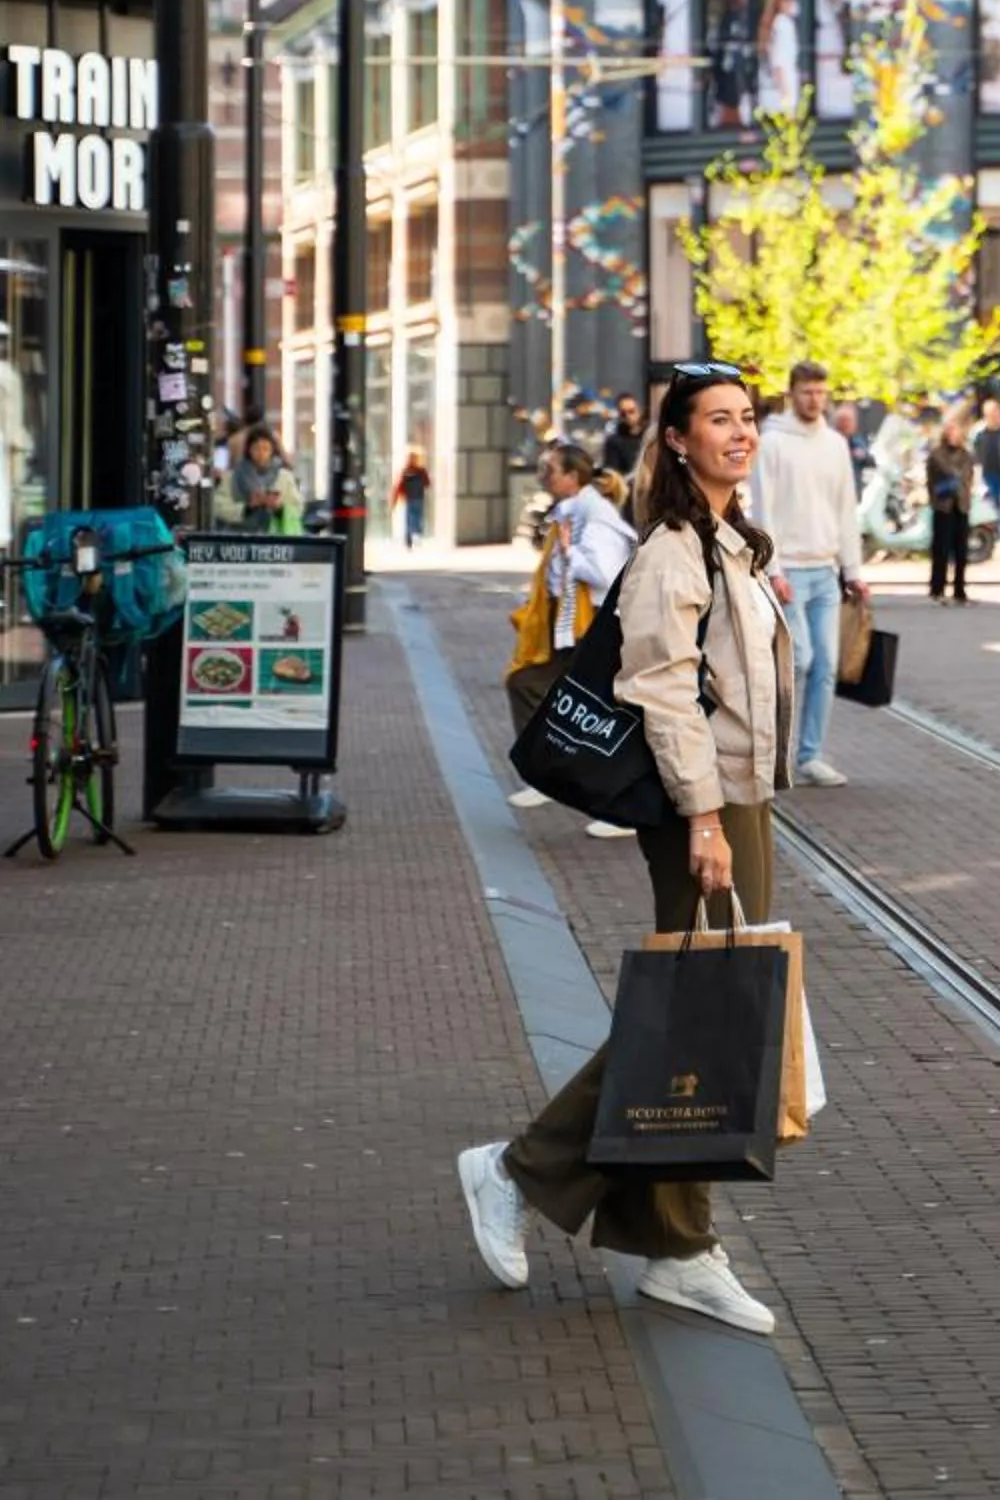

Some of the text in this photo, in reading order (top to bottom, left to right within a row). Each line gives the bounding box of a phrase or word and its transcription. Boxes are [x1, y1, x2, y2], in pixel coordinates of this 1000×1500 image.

[8, 45, 159, 130] TRAIN
[33, 131, 145, 211] MOR
[220, 544, 246, 561] YOU
